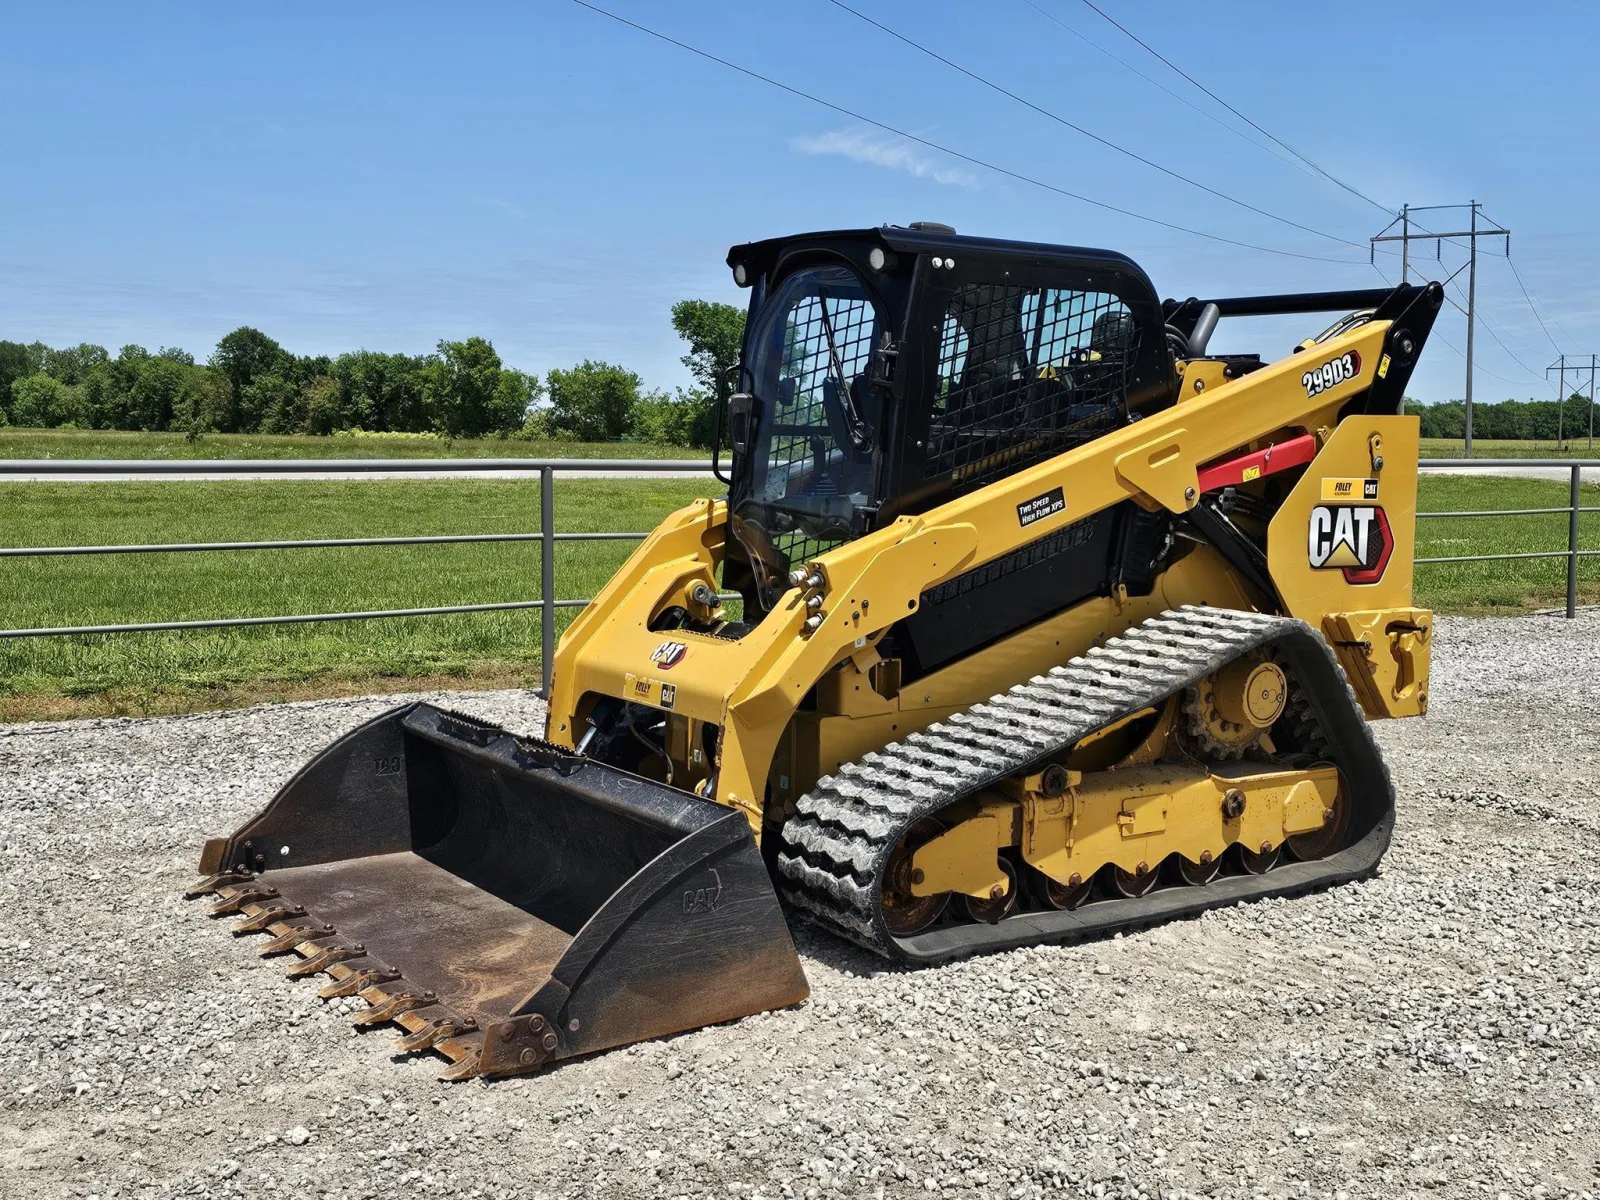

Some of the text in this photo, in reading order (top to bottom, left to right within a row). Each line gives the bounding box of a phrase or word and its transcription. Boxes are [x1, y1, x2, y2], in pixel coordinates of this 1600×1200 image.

[1302, 354, 1354, 396] 299D3
[1334, 482, 1352, 491] FOLEY
[1365, 484, 1377, 494] CAT
[1019, 497, 1050, 515] TWO SPEED
[1022, 500, 1063, 525] HIGH FLOW XPS
[1309, 507, 1374, 567] CAT
[650, 642, 685, 664] CAT
[635, 681, 651, 693] FOLEY
[682, 887, 716, 914] CAT
